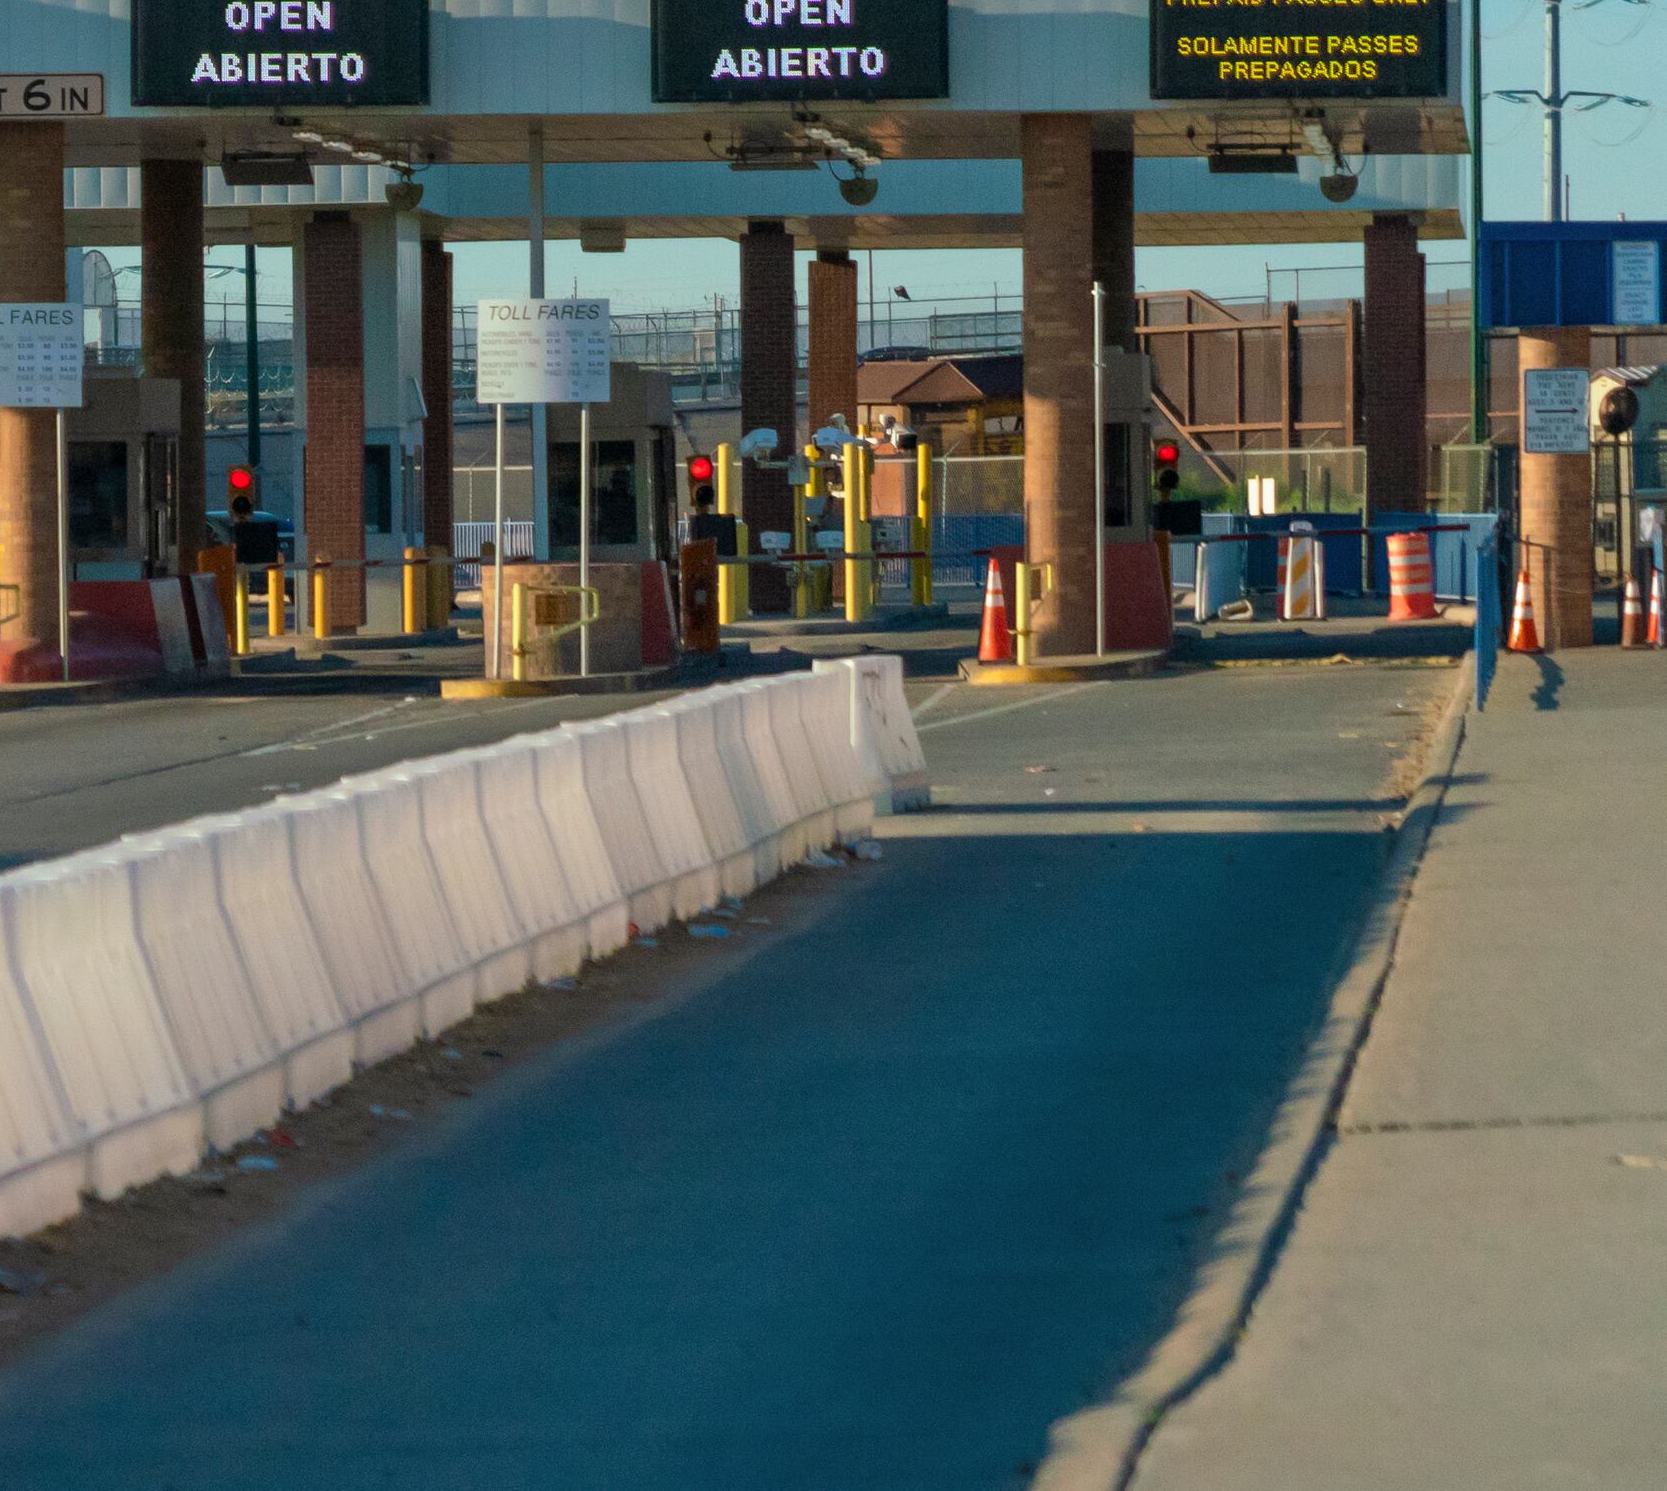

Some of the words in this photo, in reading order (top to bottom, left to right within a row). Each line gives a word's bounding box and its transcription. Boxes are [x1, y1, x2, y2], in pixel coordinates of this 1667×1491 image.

[226, 2, 330, 30] OPEN
[1179, 36, 1319, 55] SOLAMENTE
[1327, 35, 1418, 54] PASSES
[191, 53, 363, 82] ABIERTO
[711, 47, 883, 77] ABIERTO
[1220, 60, 1376, 79] PREPAGADOS
[23, 79, 51, 111] 6
[61, 87, 89, 110] IN
[11, 309, 73, 325] FARES
[490, 305, 531, 321] TOLL
[537, 305, 599, 319] FARES
